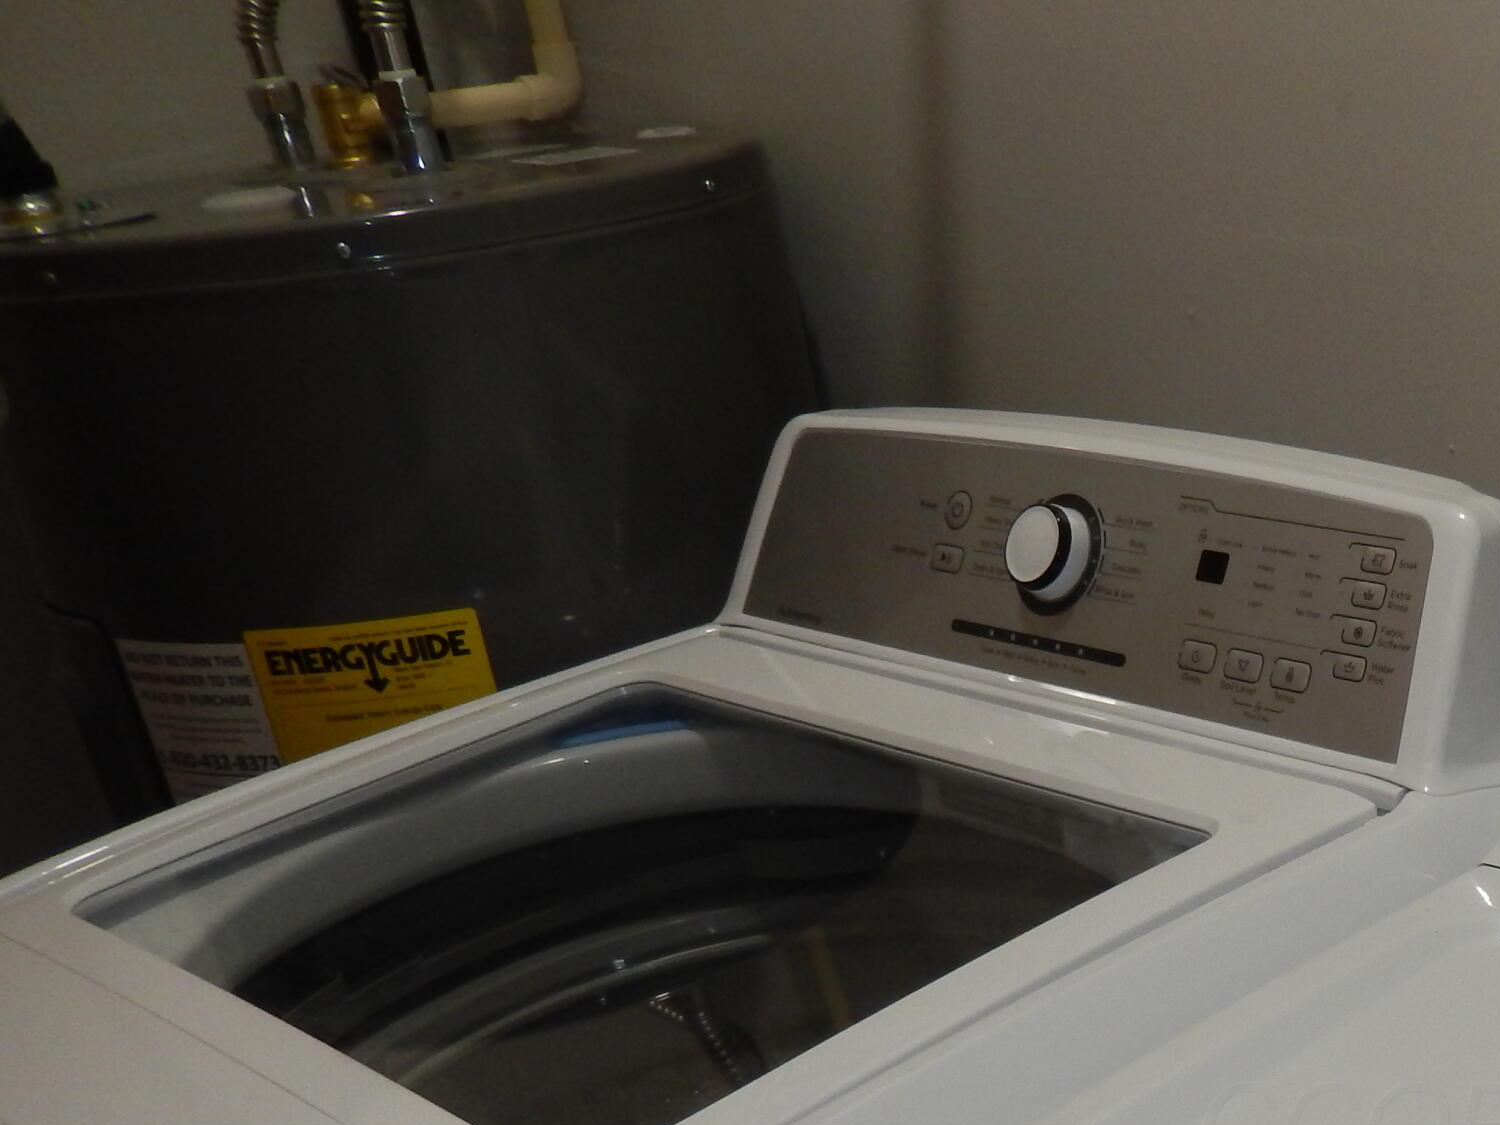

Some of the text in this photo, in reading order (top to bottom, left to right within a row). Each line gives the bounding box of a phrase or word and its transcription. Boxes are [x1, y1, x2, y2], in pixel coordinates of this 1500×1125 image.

[264, 628, 472, 678] ENERGYGUIDE
[213, 655, 244, 668] THIS
[207, 674, 227, 688] TO
[228, 675, 253, 688] THE
